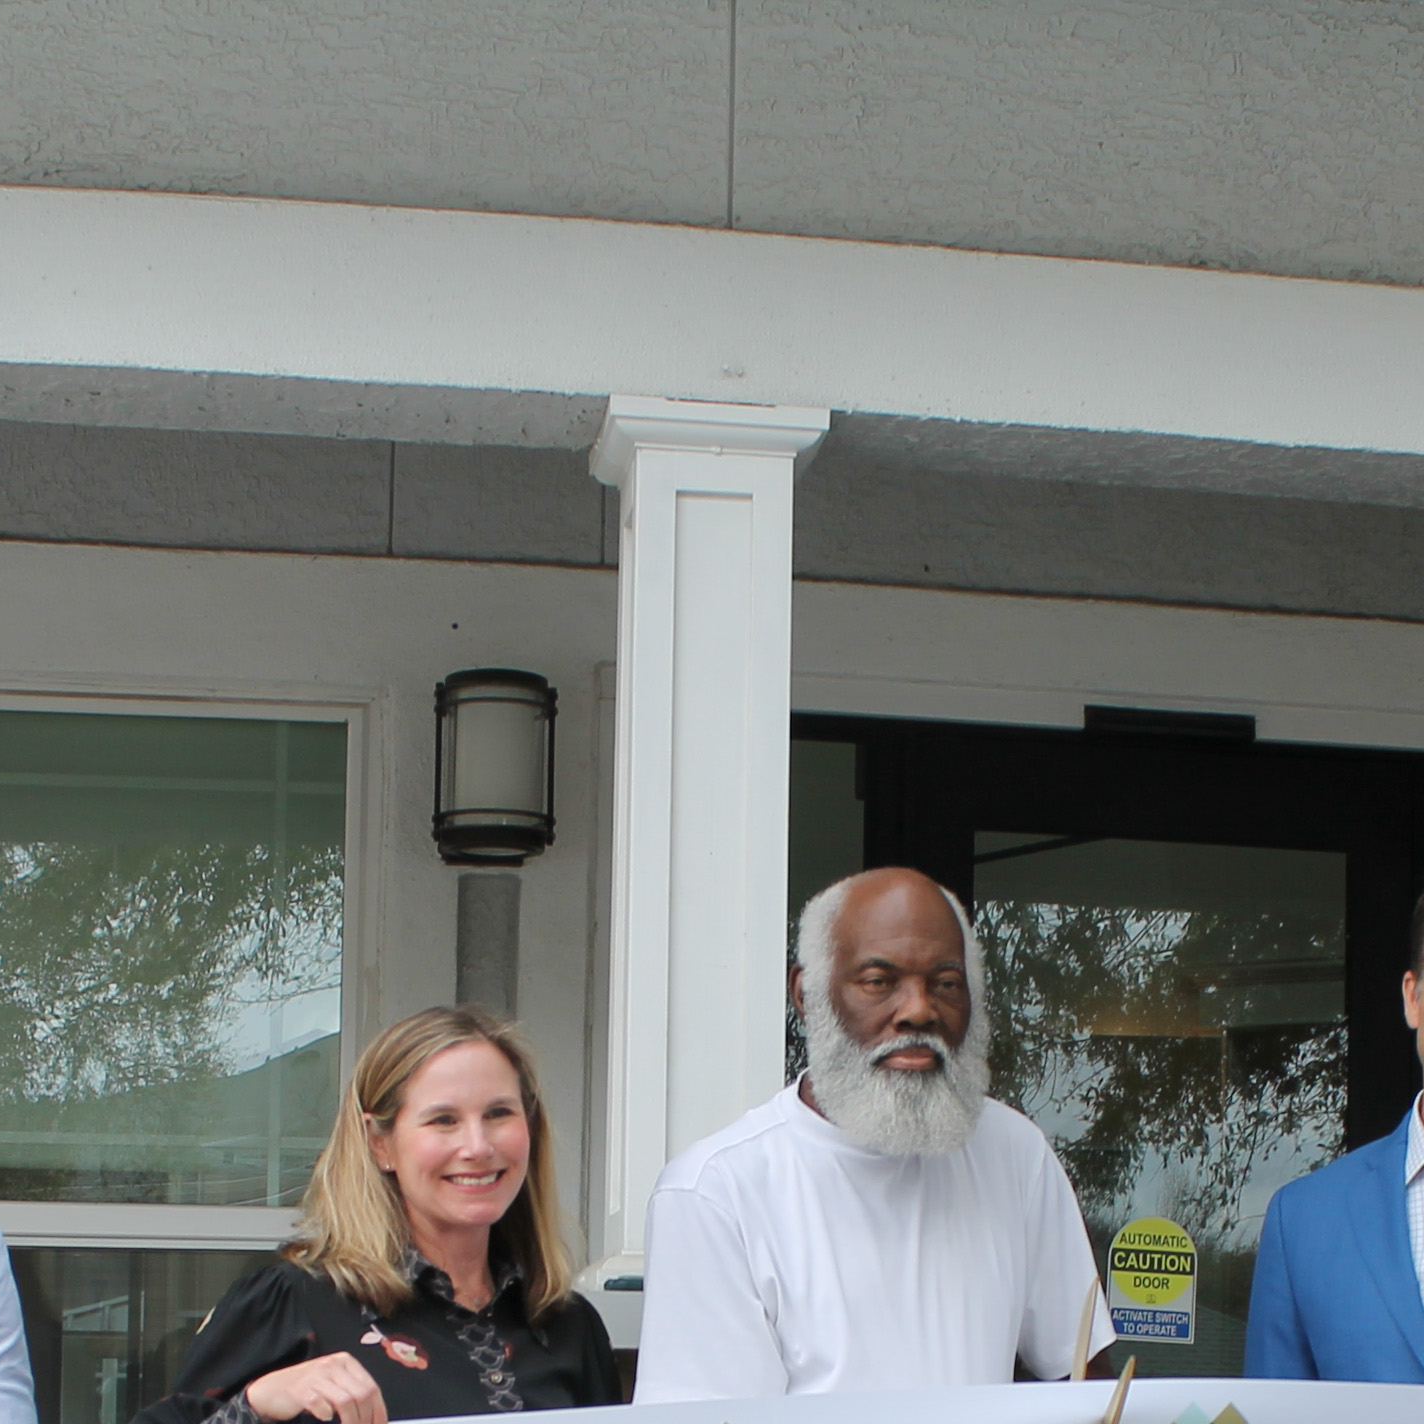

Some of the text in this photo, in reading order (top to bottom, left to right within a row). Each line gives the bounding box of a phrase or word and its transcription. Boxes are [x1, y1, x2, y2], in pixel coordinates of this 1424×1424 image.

[1119, 1232, 1188, 1248] AUTOMATIC
[1113, 1251, 1191, 1272] CAUTION
[1133, 1276, 1170, 1290] DOOR
[1112, 1309, 1189, 1325] ACTIVATE SWITCH
[1123, 1322, 1177, 1336] TO OPERATE
